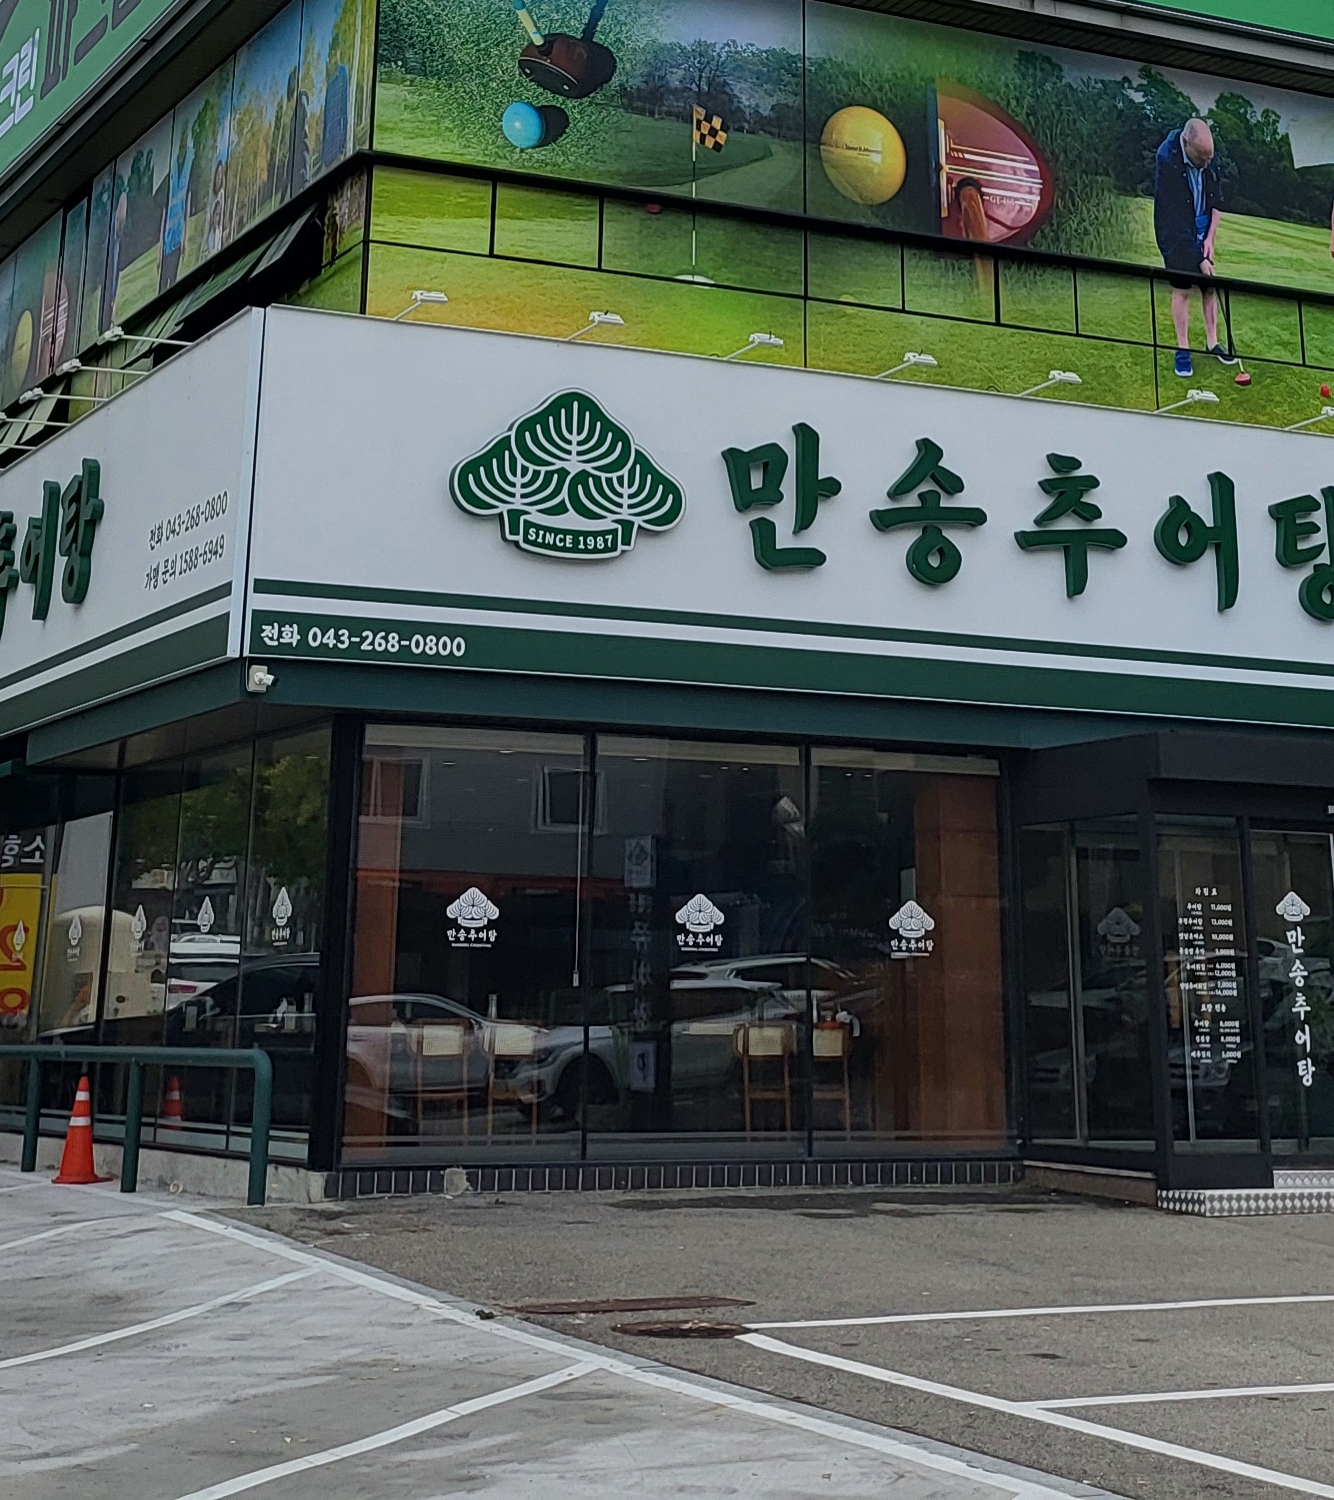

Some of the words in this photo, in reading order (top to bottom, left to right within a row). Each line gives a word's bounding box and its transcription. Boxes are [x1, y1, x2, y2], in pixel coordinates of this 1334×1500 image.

[149, 519, 164, 552] 전화
[165, 490, 229, 542] 043-268-0800
[527, 527, 574, 548] SINCE
[577, 534, 614, 550] 1987
[144, 561, 161, 592] 가맹
[161, 553, 178, 585] 문의
[178, 533, 225, 577] 1588-6949
[260, 622, 301, 648] 전화
[307, 626, 466, 657] 043-268-0800
[1285, 925, 1316, 1087] 만송추어탕
